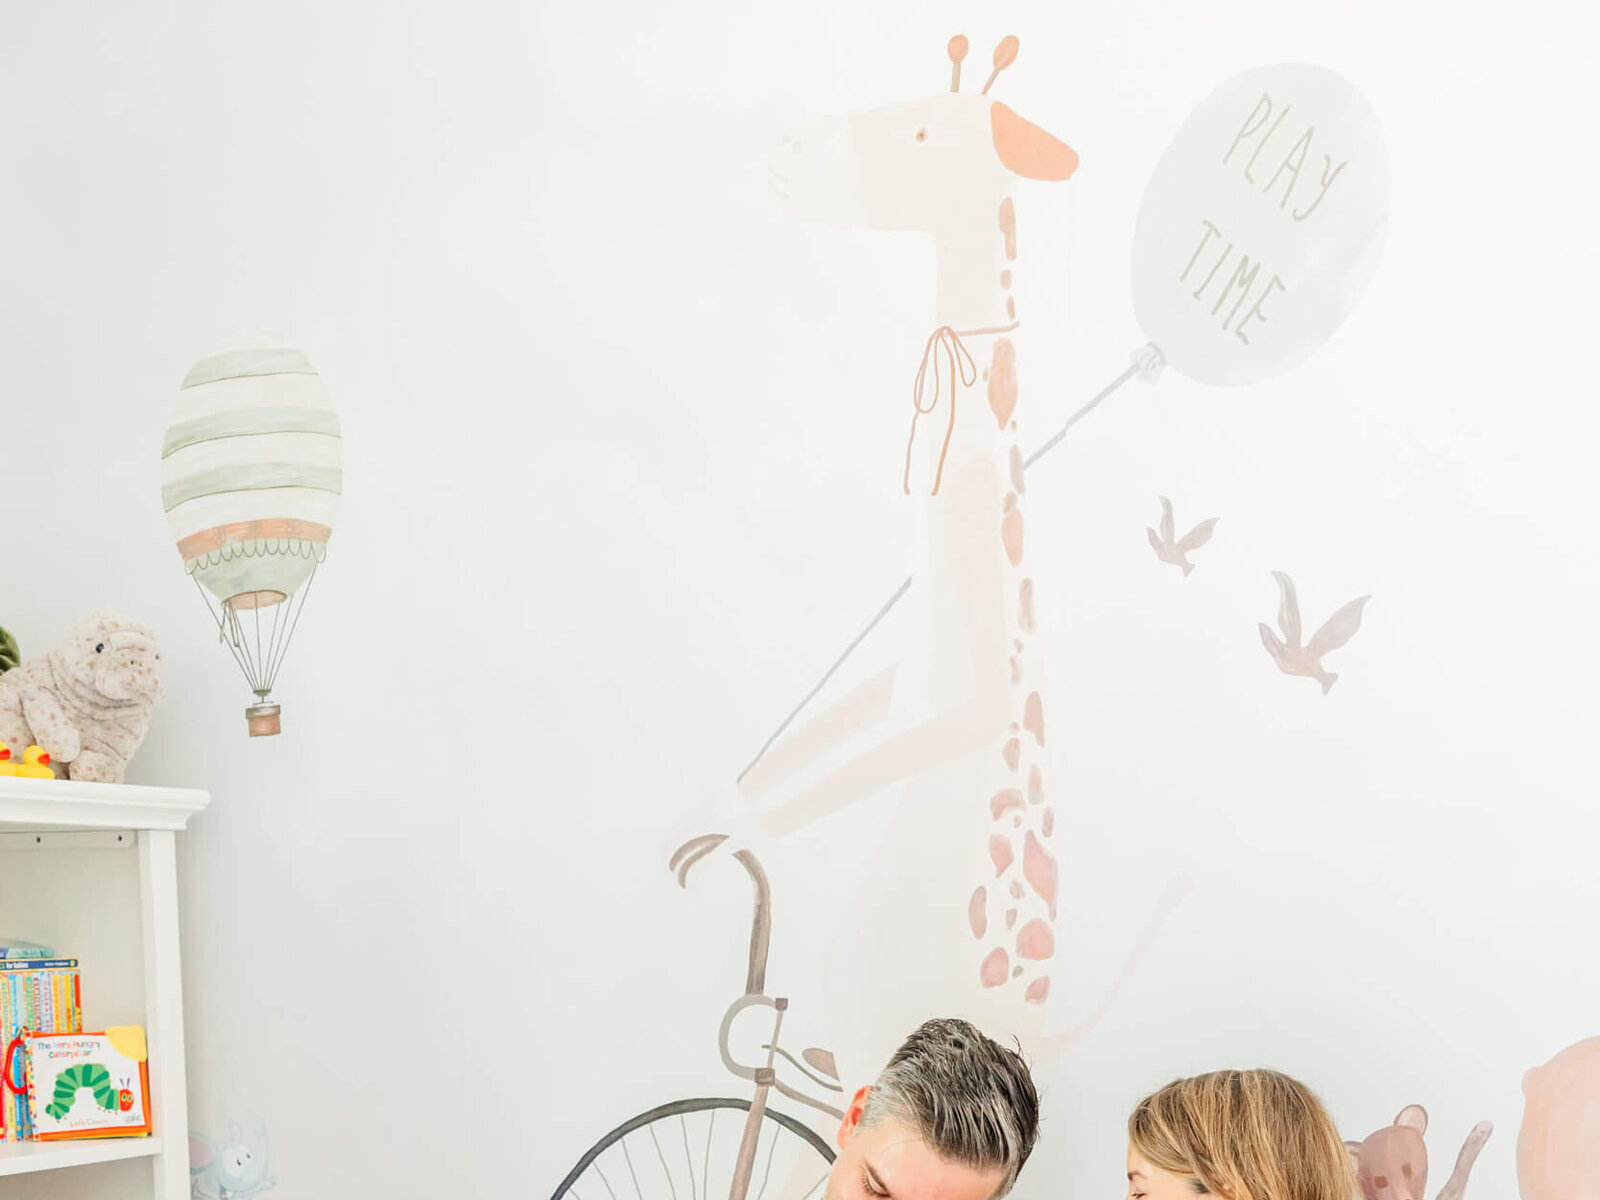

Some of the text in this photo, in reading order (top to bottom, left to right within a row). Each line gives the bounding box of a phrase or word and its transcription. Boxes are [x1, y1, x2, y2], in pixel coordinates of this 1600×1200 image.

[1222, 92, 1348, 222] PLAY
[1179, 219, 1287, 346] TIME
[36, 1042, 51, 1051] The
